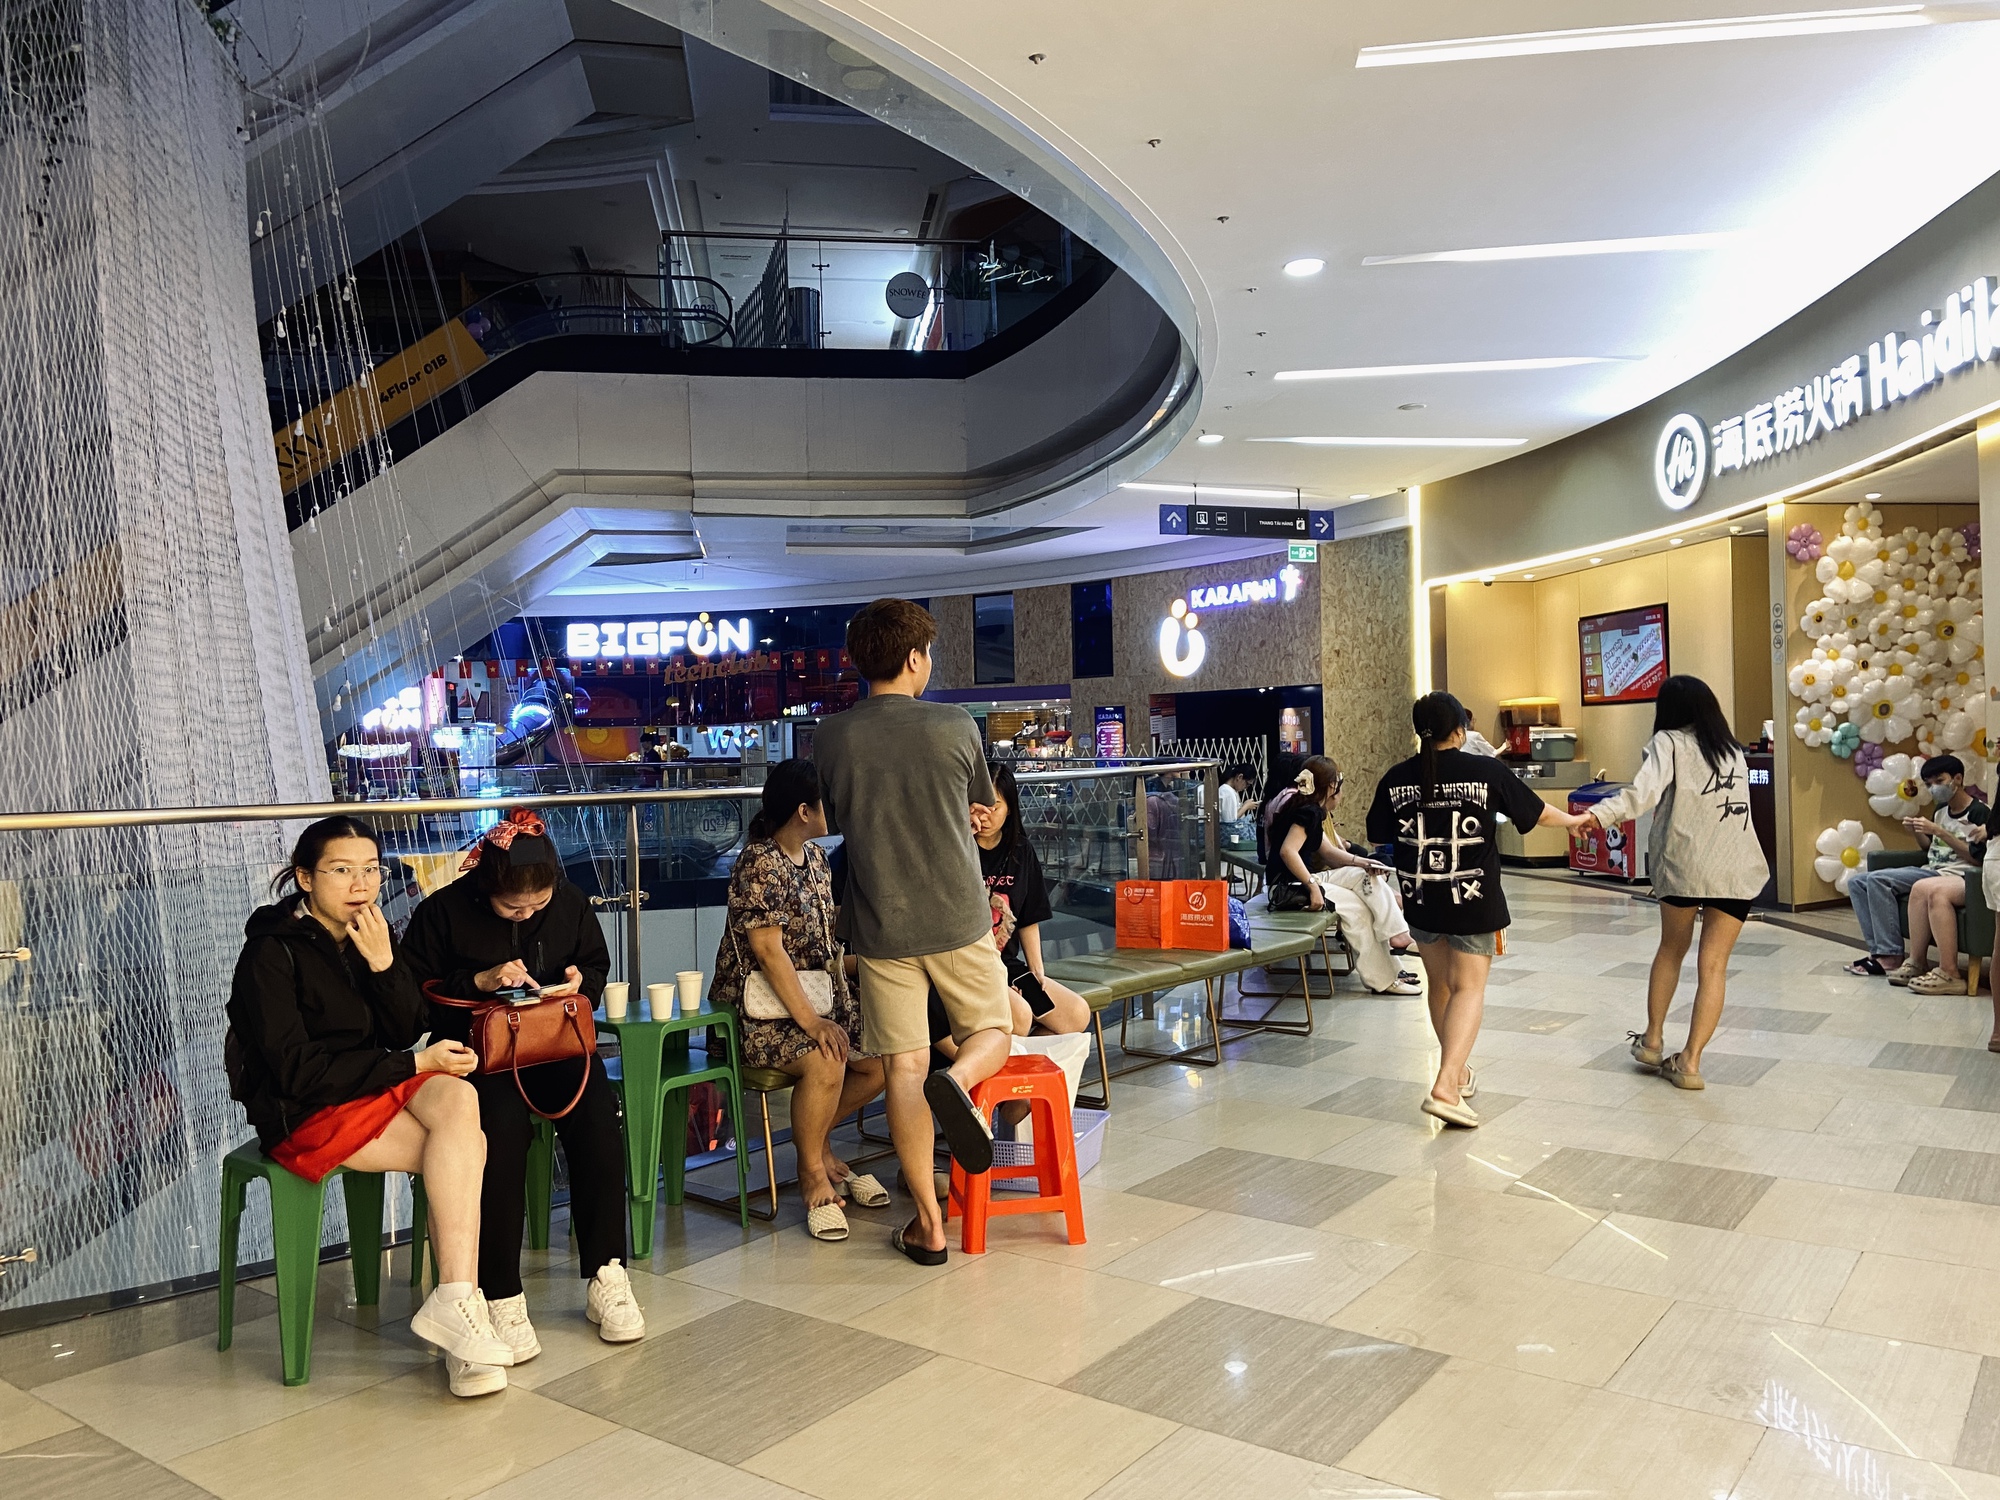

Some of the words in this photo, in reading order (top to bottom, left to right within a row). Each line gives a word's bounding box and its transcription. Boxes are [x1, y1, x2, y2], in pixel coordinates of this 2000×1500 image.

[380, 371, 421, 404] 4Floor
[423, 353, 448, 375] 01B
[1712, 354, 1864, 477] 海底捞火锅
[565, 617, 752, 657] BIGFUN
[1747, 768, 1769, 785] 底捞
[1388, 784, 1422, 813] NEEDS
[1441, 781, 1488, 811] WISDOM
